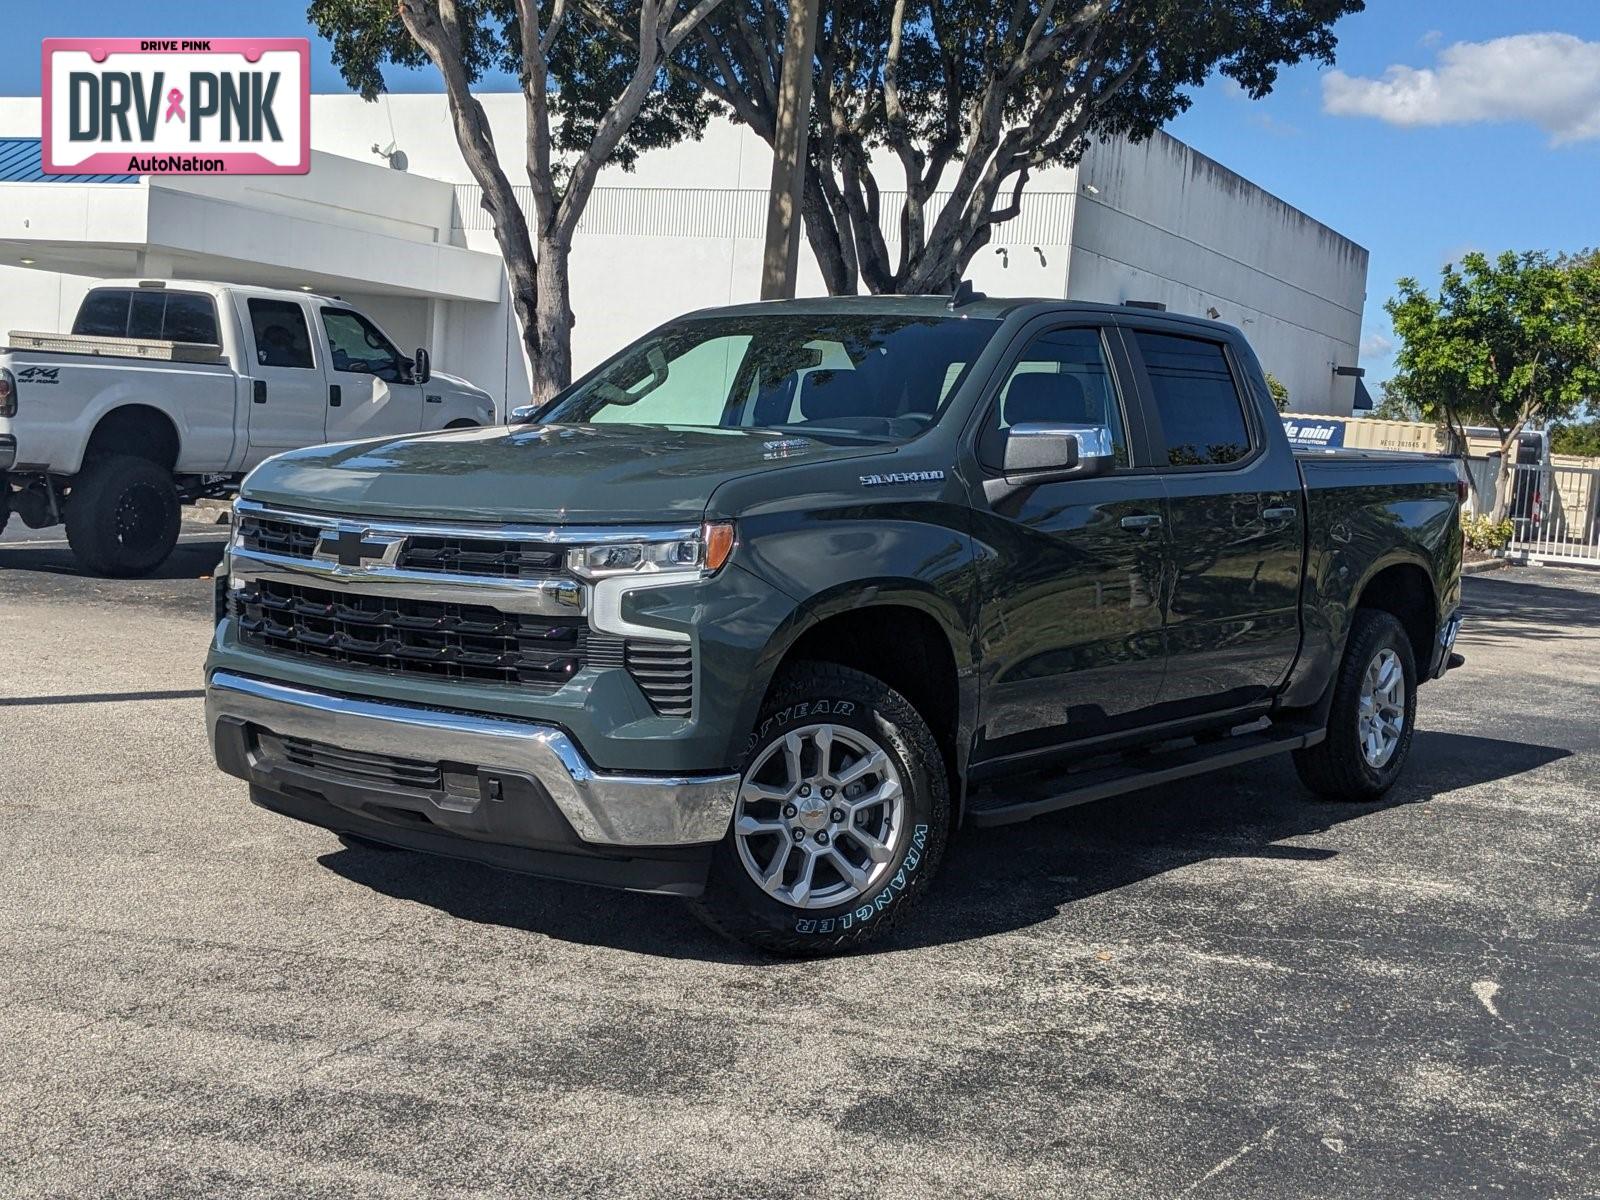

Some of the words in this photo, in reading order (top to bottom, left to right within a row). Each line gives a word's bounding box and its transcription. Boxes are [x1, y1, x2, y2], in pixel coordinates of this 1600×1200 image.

[1299, 425, 1336, 440] mini
[859, 470, 945, 486] SILVERADO
[796, 824, 928, 933] WRANGLER
